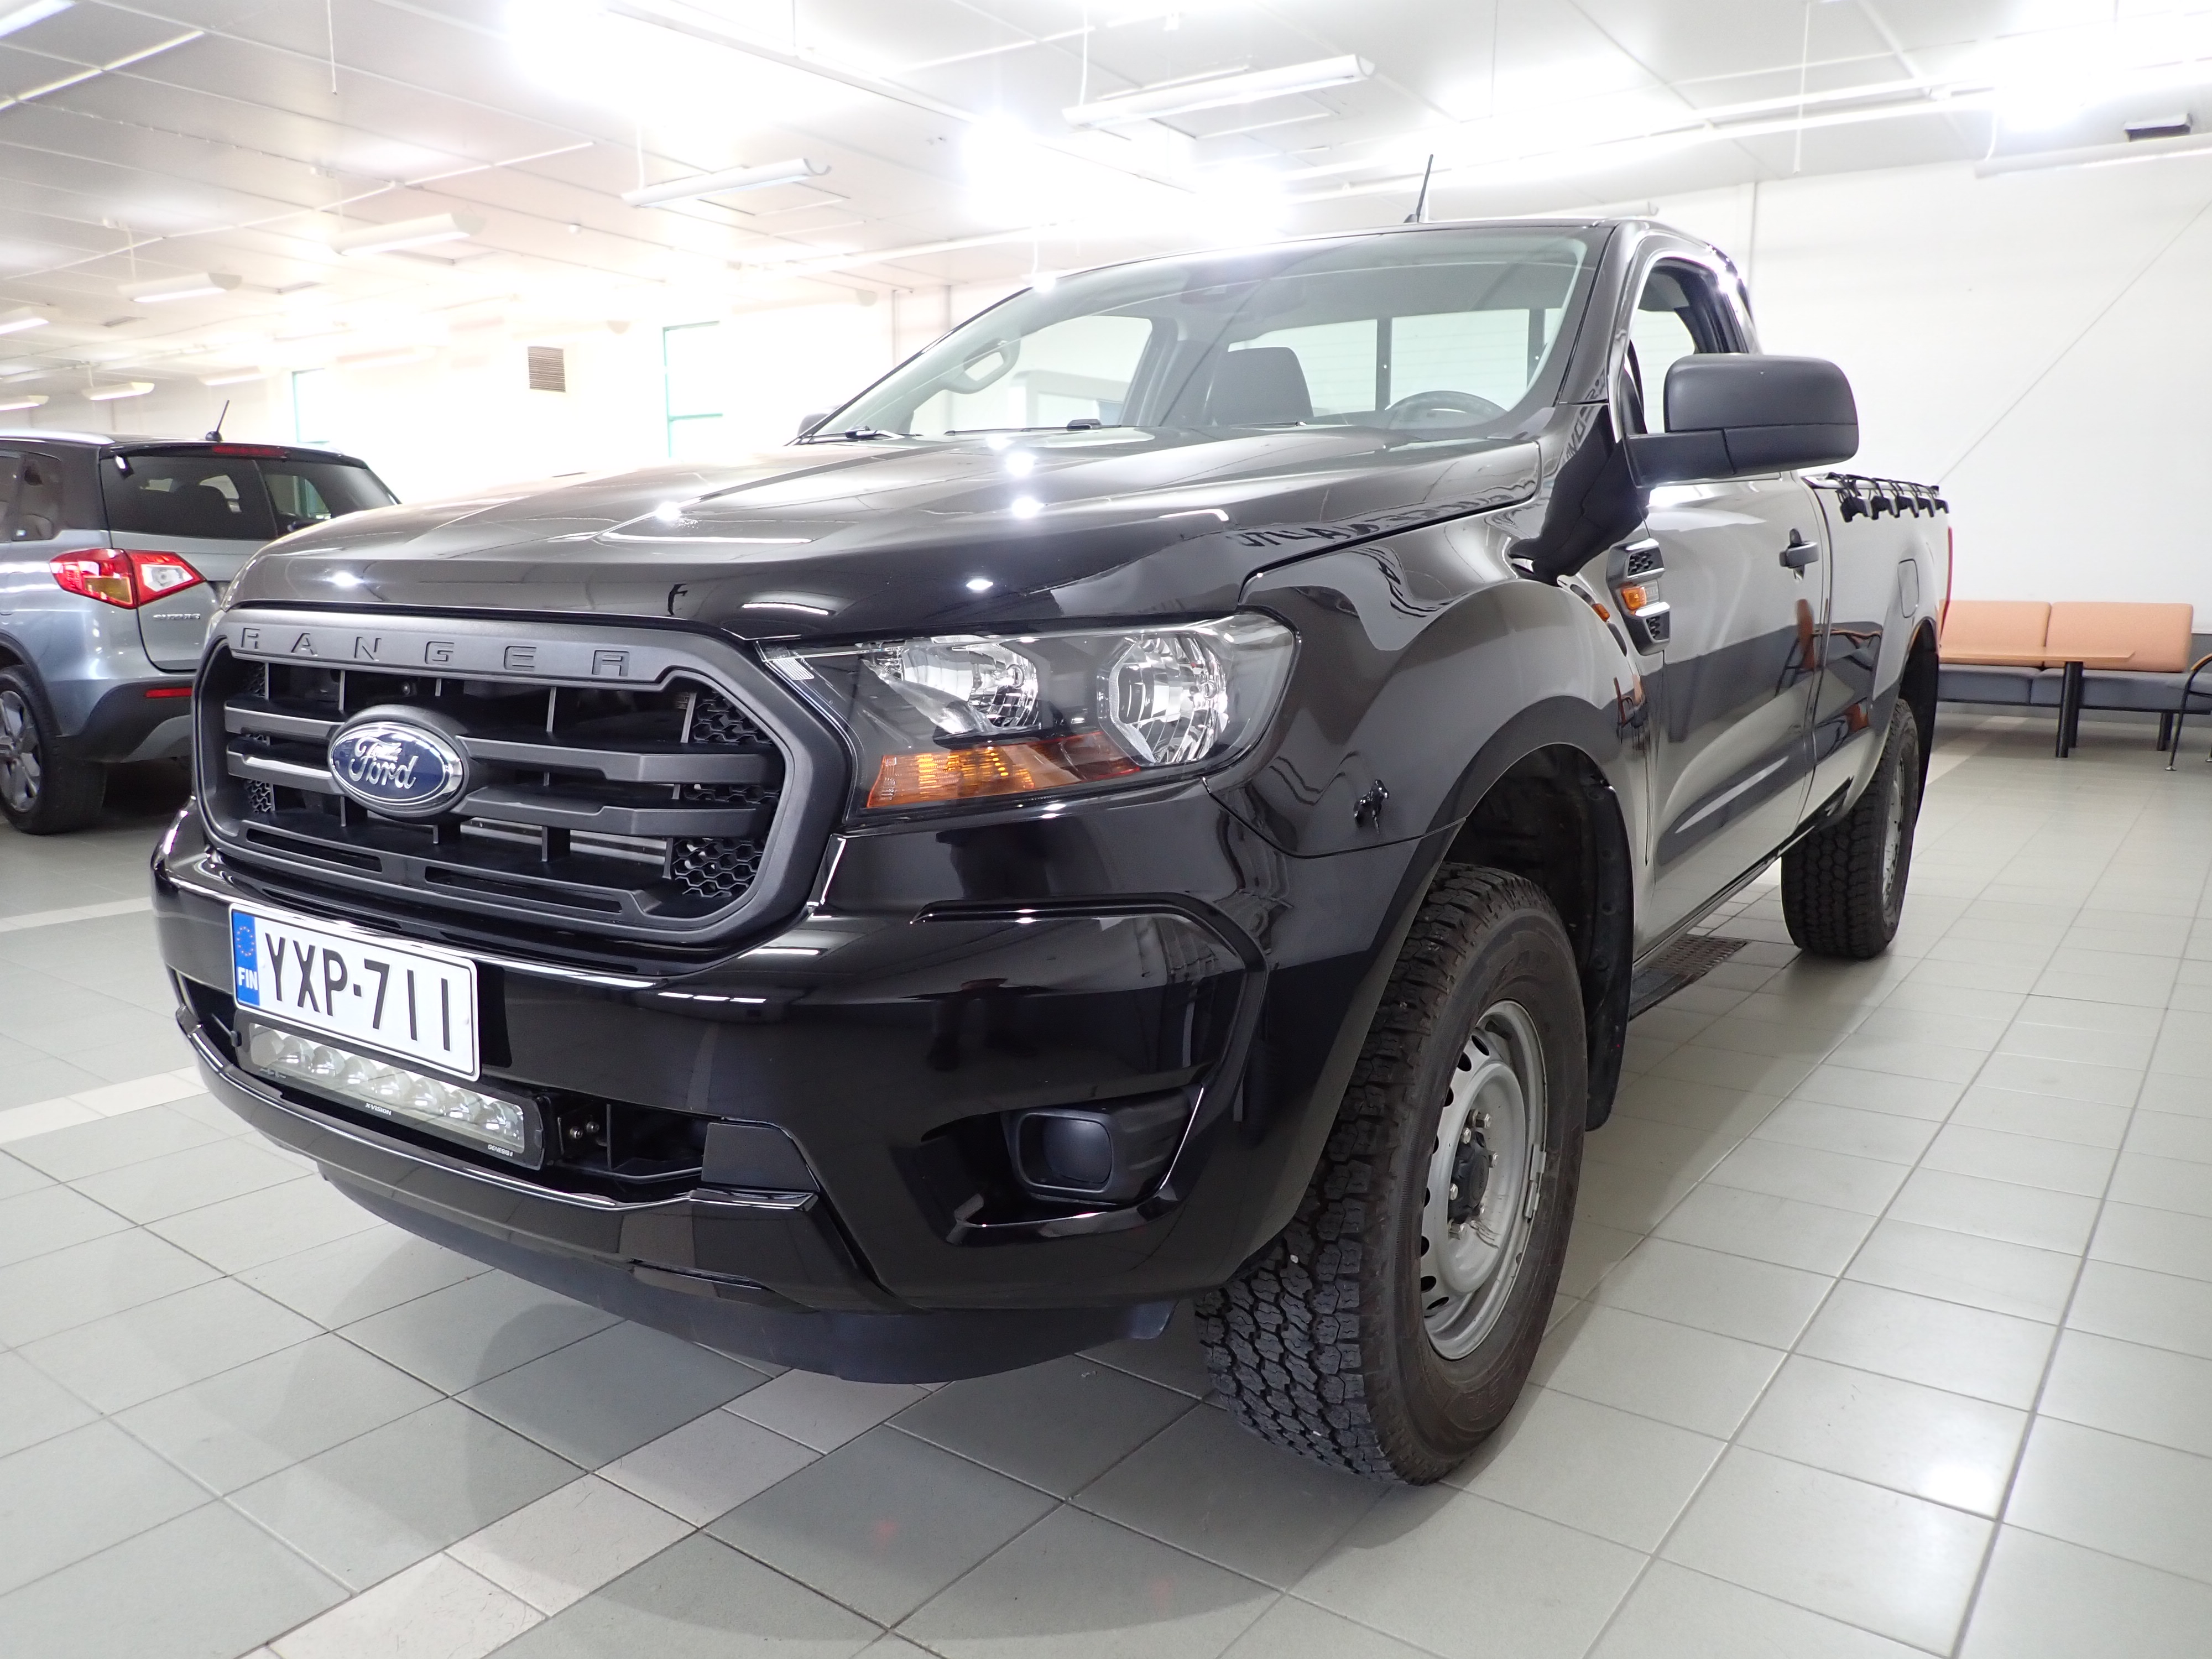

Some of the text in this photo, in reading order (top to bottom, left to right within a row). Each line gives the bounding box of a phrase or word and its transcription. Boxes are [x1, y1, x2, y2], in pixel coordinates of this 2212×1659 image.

[241, 627, 630, 677] RANGER
[348, 735, 419, 789] Ford
[238, 967, 258, 990] FIN
[265, 932, 452, 1052] YXP-711
